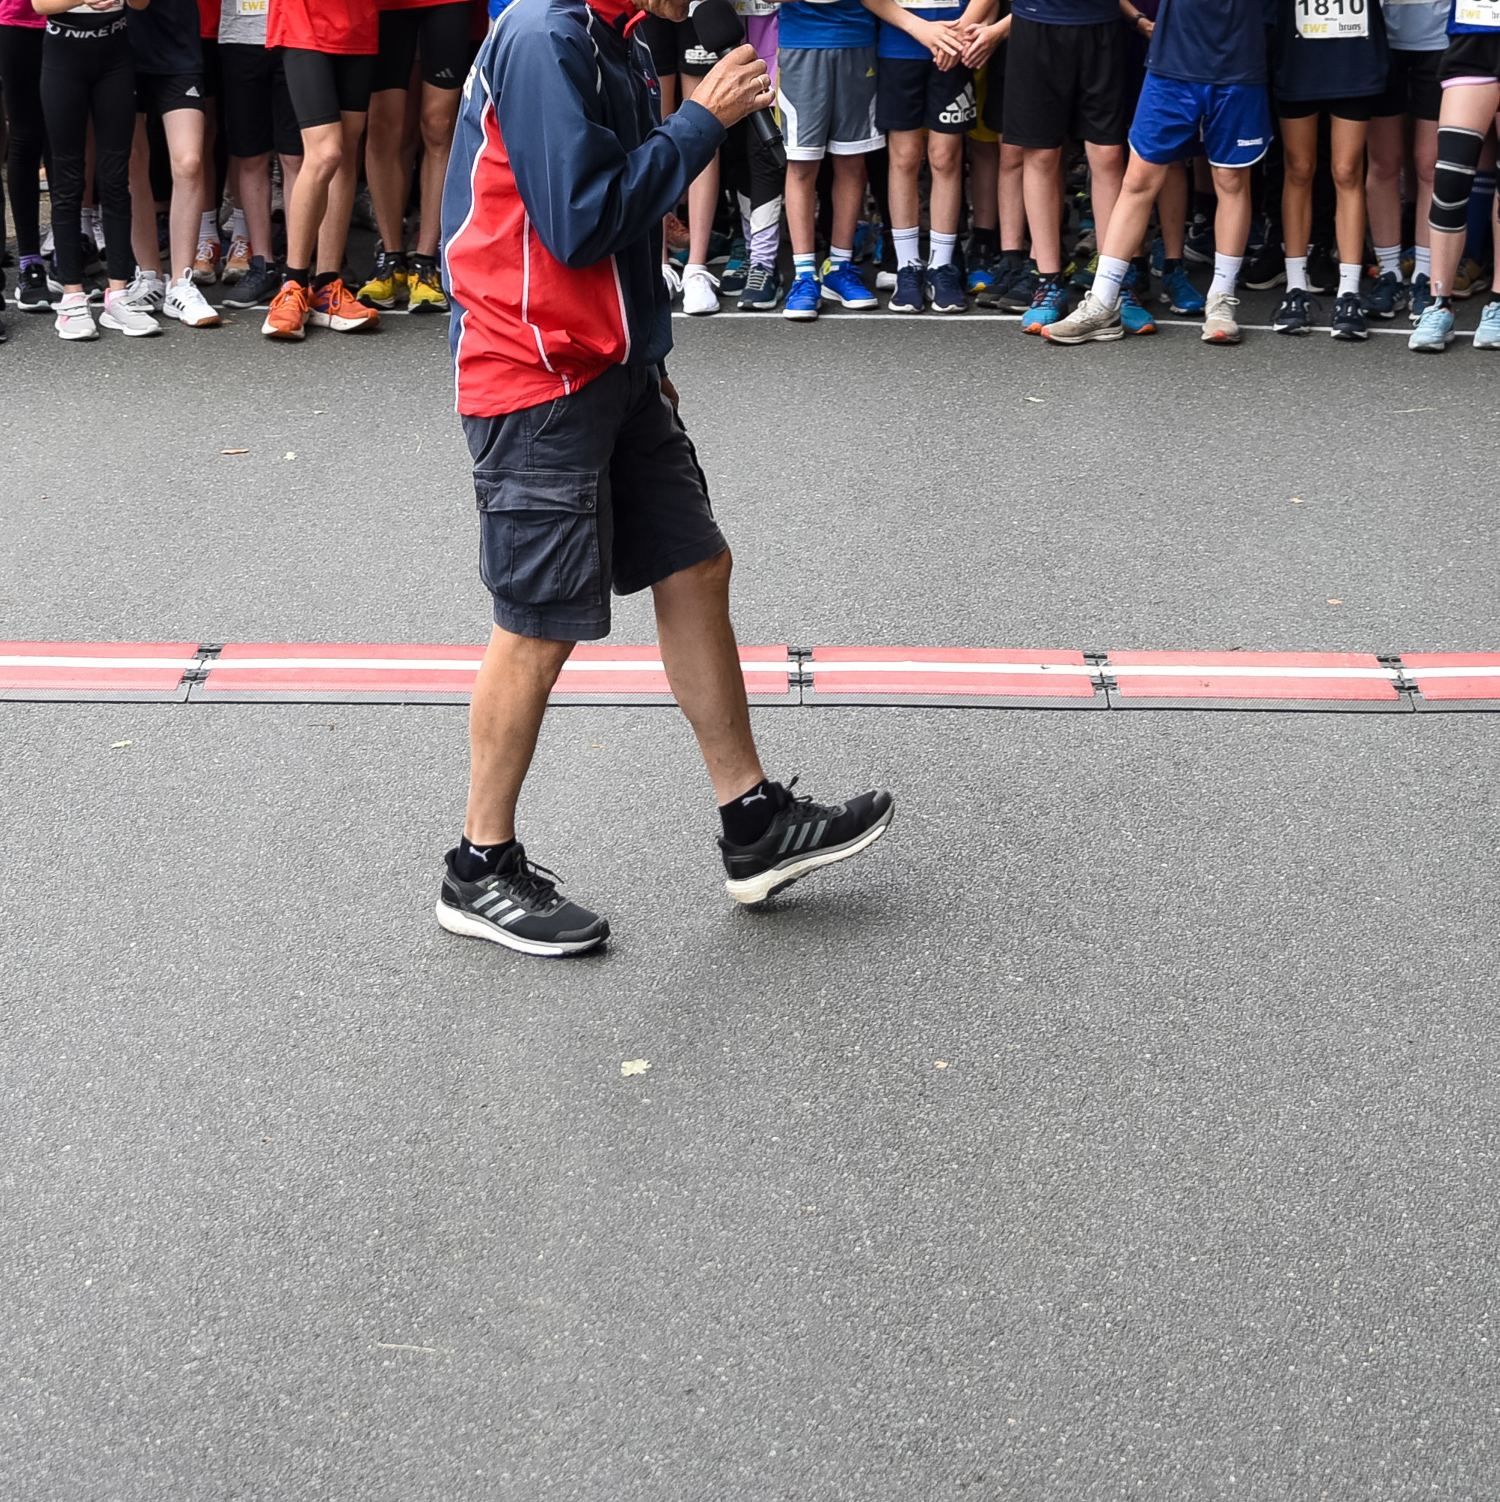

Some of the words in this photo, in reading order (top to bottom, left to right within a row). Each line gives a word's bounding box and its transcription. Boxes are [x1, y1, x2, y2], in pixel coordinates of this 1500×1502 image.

[242, 1, 266, 10] EWE
[65, 25, 109, 39] NIKE
[1302, 23, 1328, 34] EWE
[1339, 21, 1361, 31] bruns
